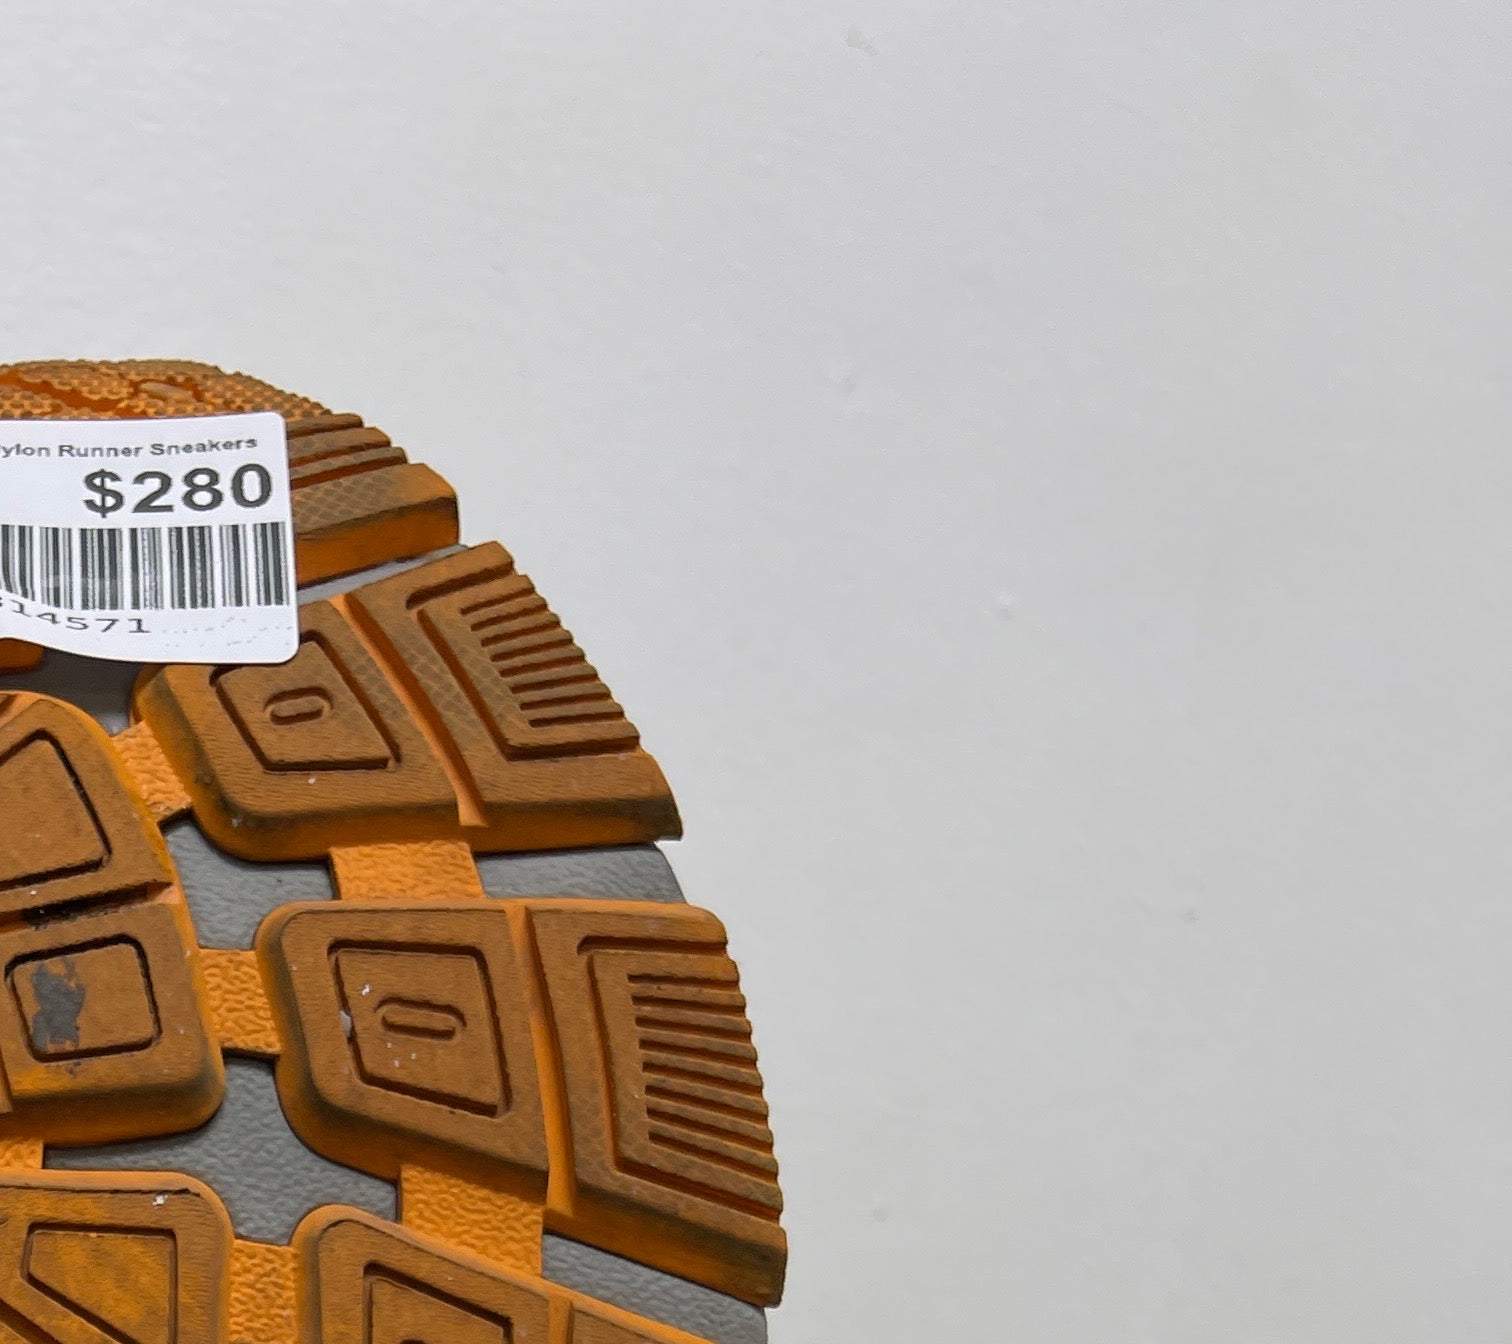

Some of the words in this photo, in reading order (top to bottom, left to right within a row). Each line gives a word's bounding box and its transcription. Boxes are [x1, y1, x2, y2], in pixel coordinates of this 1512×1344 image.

[58, 444, 142, 458] Runner
[150, 438, 258, 456] Sneakers
[83, 463, 272, 518] $280
